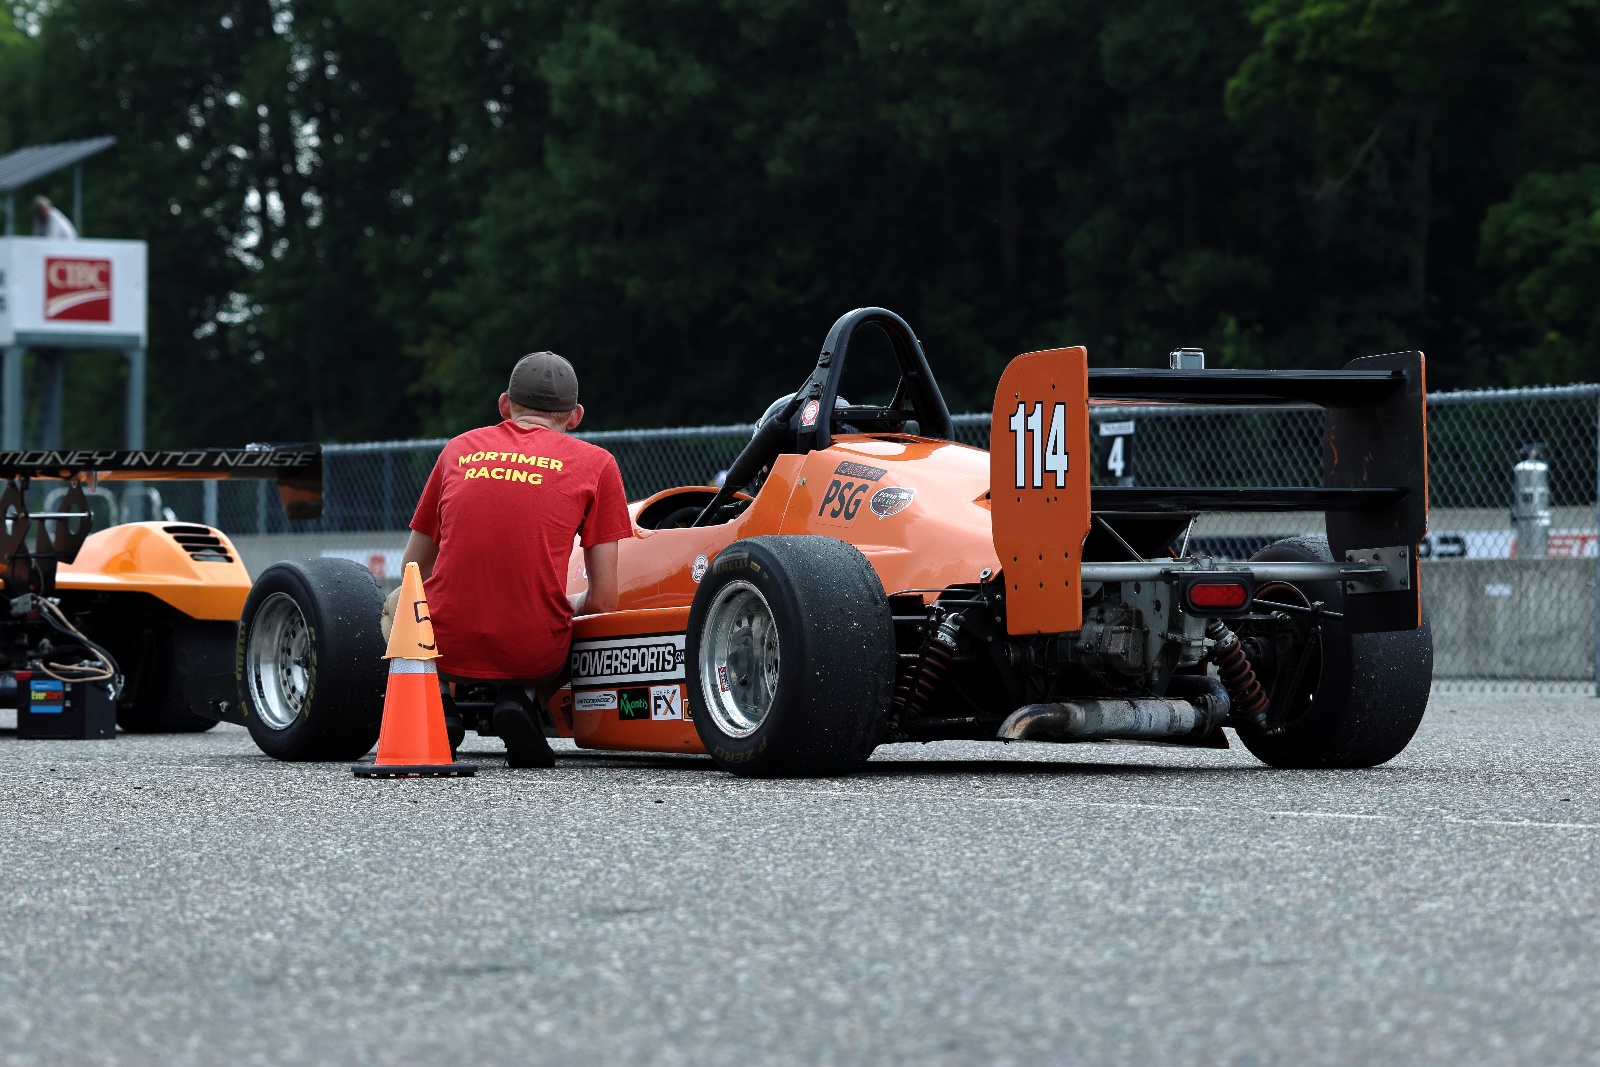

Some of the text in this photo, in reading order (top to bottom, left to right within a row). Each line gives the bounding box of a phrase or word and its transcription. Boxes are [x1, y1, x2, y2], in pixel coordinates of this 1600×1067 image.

[49, 260, 107, 289] CIBC
[0, 451, 314, 467] MONEY INTO NOISE
[1009, 401, 1069, 490] 114
[1108, 436, 1125, 477] 4
[458, 450, 564, 472] MORTIMER
[464, 467, 544, 485] RACING
[818, 479, 869, 520] PSG
[713, 552, 750, 575] PIRELLI
[413, 600, 436, 650] 5
[236, 620, 247, 681] PIRELLI
[571, 645, 674, 677] POWERSPORTS
[31, 690, 63, 701] EverStart
[304, 647, 318, 719] ZERO
[620, 693, 649, 717] Mantis
[654, 689, 678, 715] FX
[713, 744, 755, 763] ZERO
